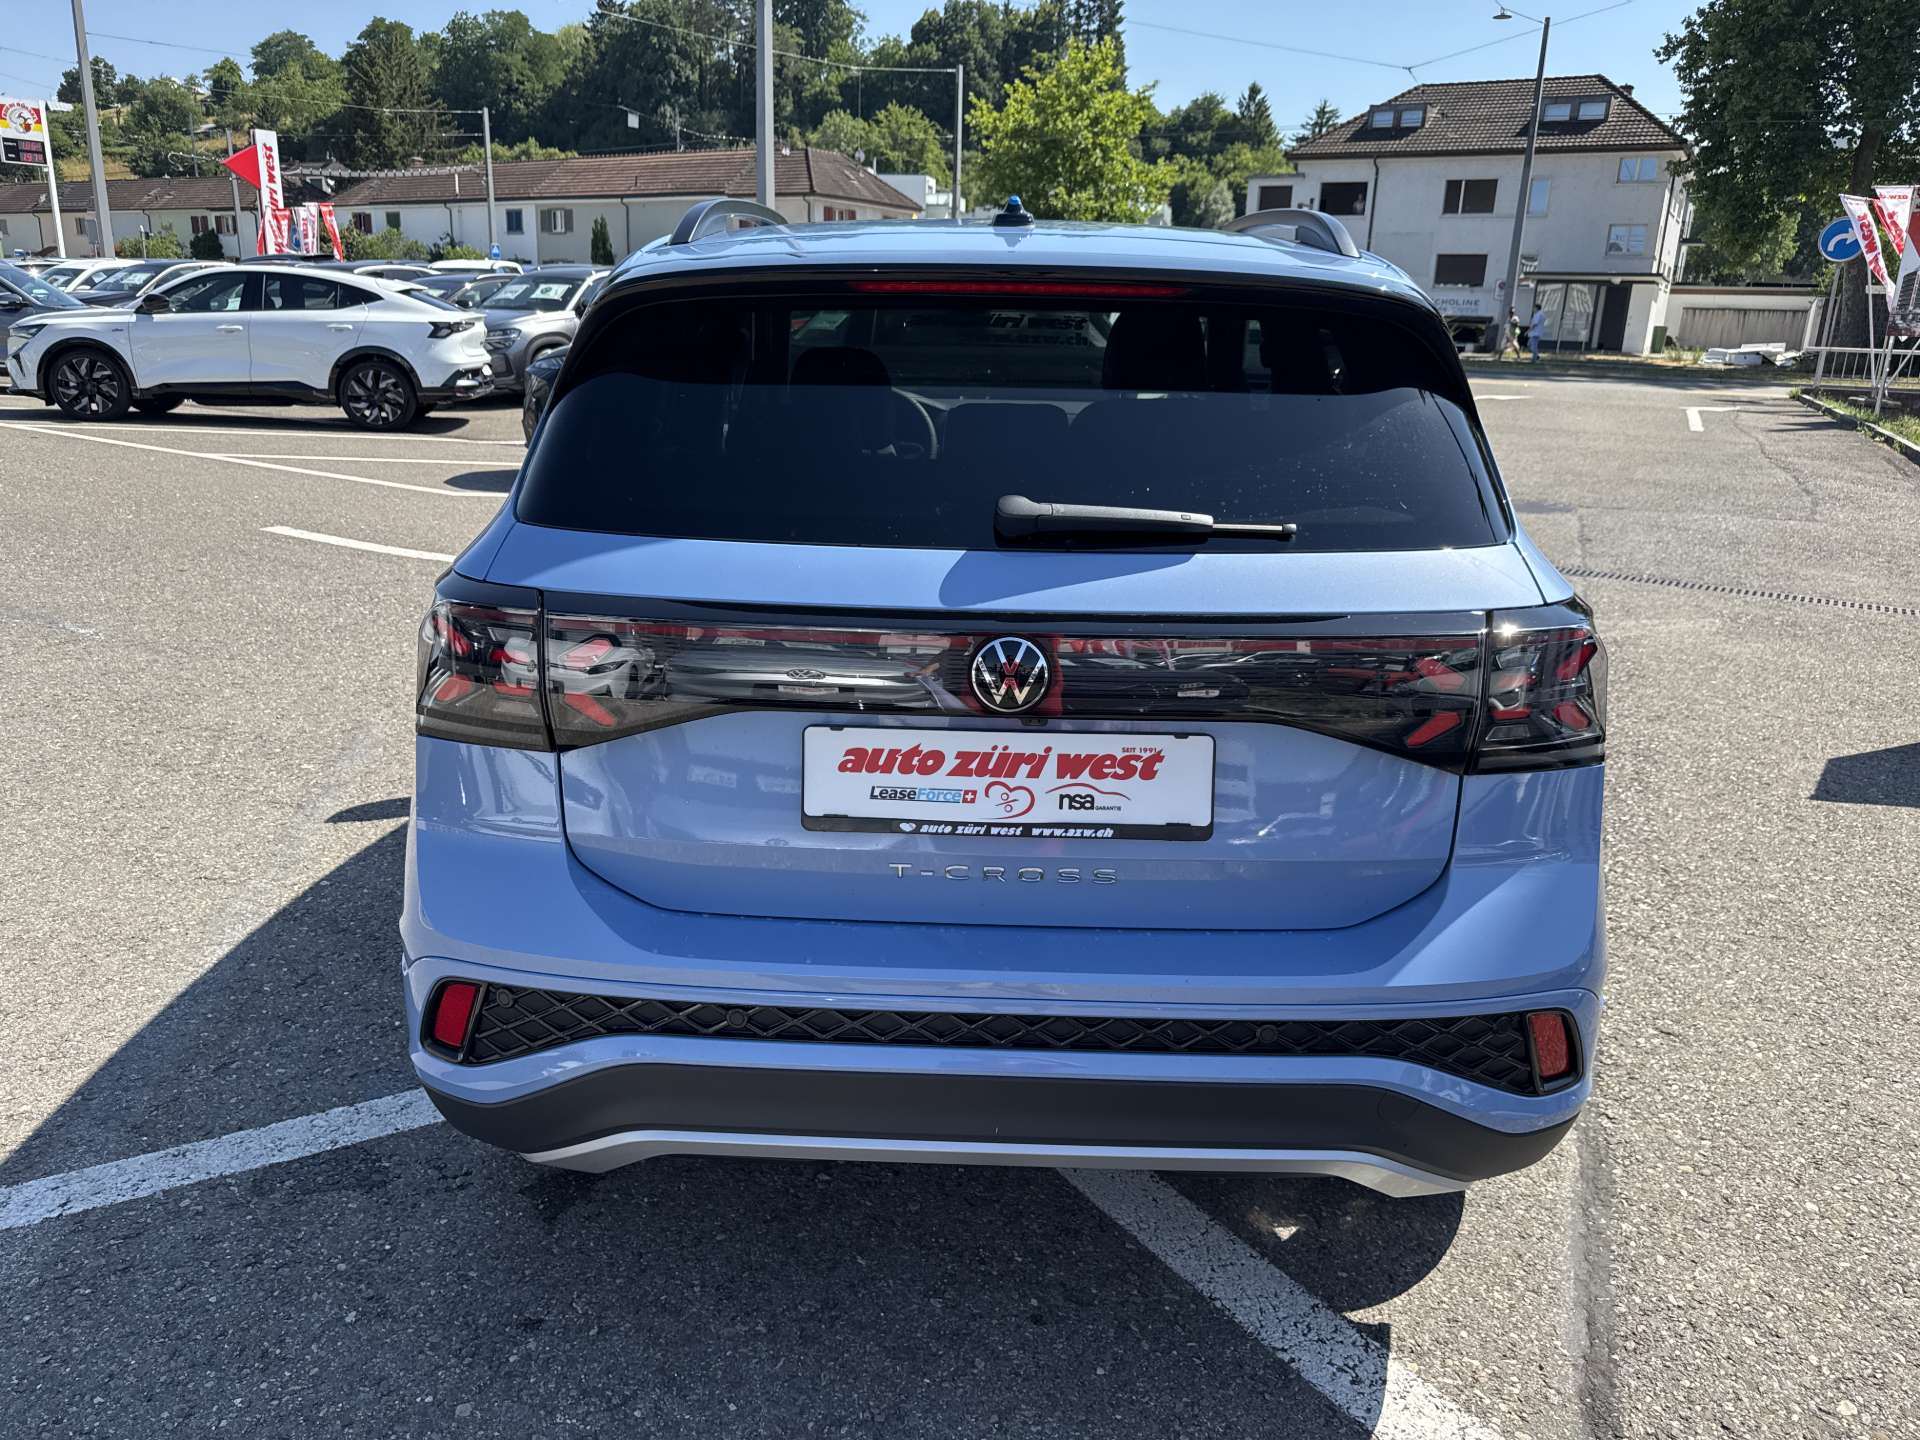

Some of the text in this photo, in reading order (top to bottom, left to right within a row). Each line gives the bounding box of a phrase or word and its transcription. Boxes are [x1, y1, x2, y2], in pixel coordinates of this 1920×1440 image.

[261, 142, 276, 184] west
[838, 743, 1165, 781] auto züri west
[869, 786, 962, 803] LeaseForce
[1059, 793, 1095, 811] nsa
[920, 823, 1114, 838] auto züri west www.azw.ch
[889, 863, 1119, 884] T-CROSS
